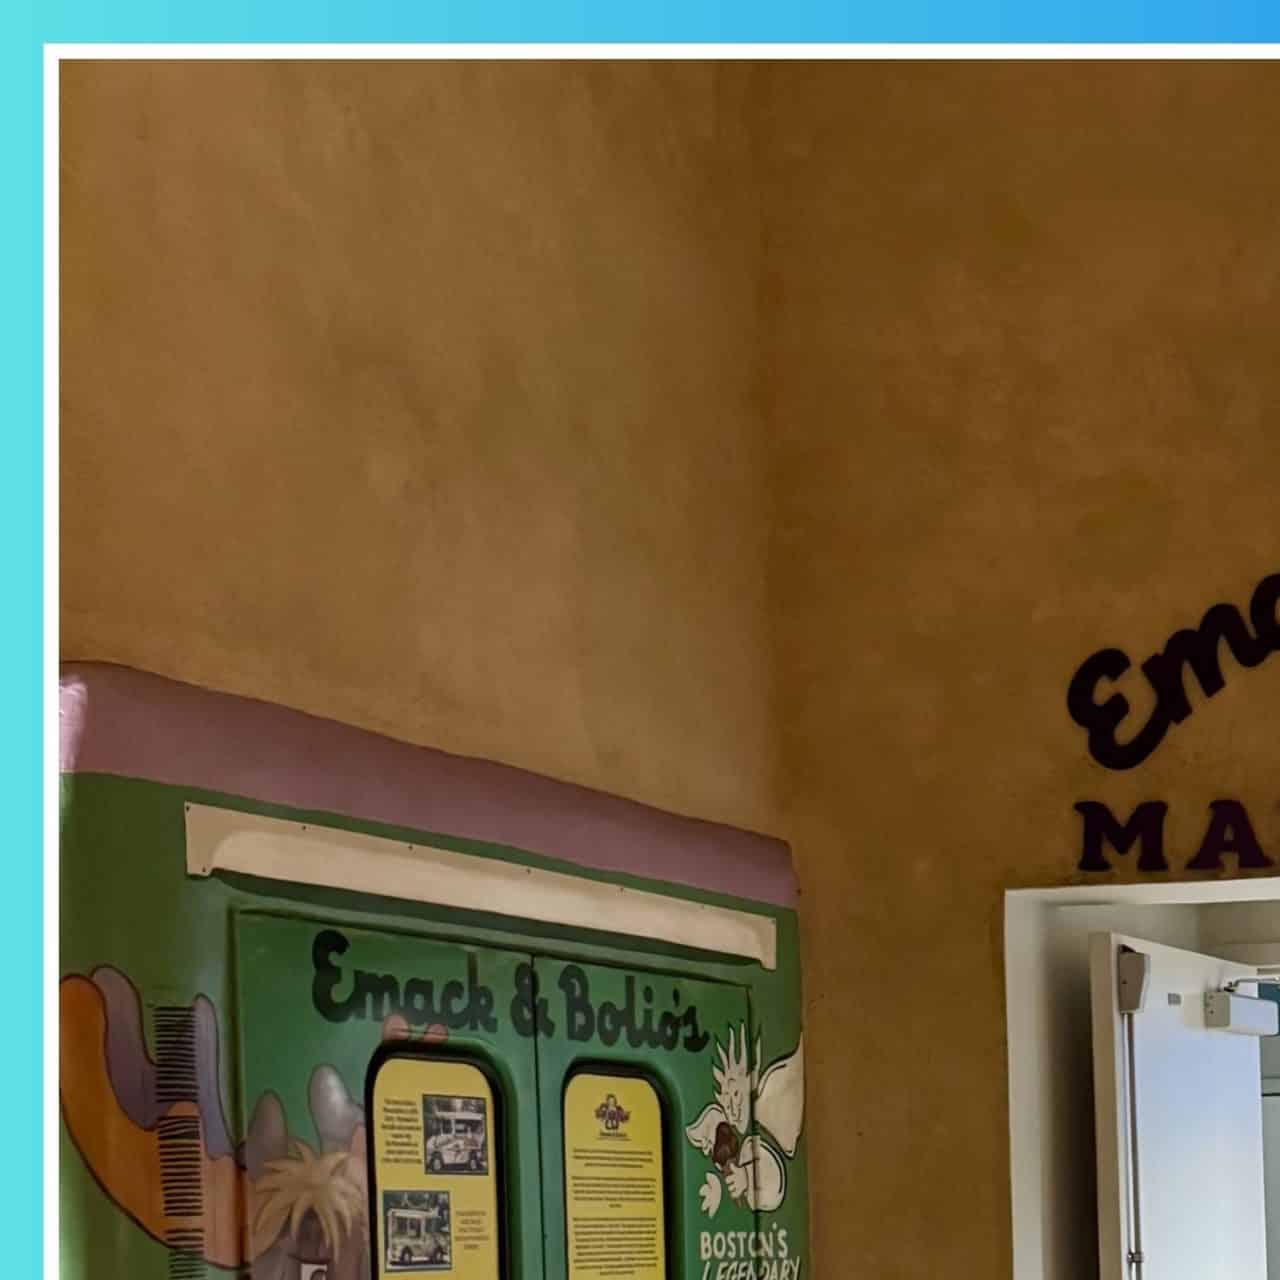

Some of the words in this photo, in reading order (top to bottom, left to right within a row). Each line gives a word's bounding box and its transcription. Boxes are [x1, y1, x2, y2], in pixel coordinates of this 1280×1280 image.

[311, 929, 497, 1034] Emack
[510, 962, 555, 1039] &
[559, 964, 710, 1052] Bolio's
[700, 1222, 788, 1260] BOSTON'S
